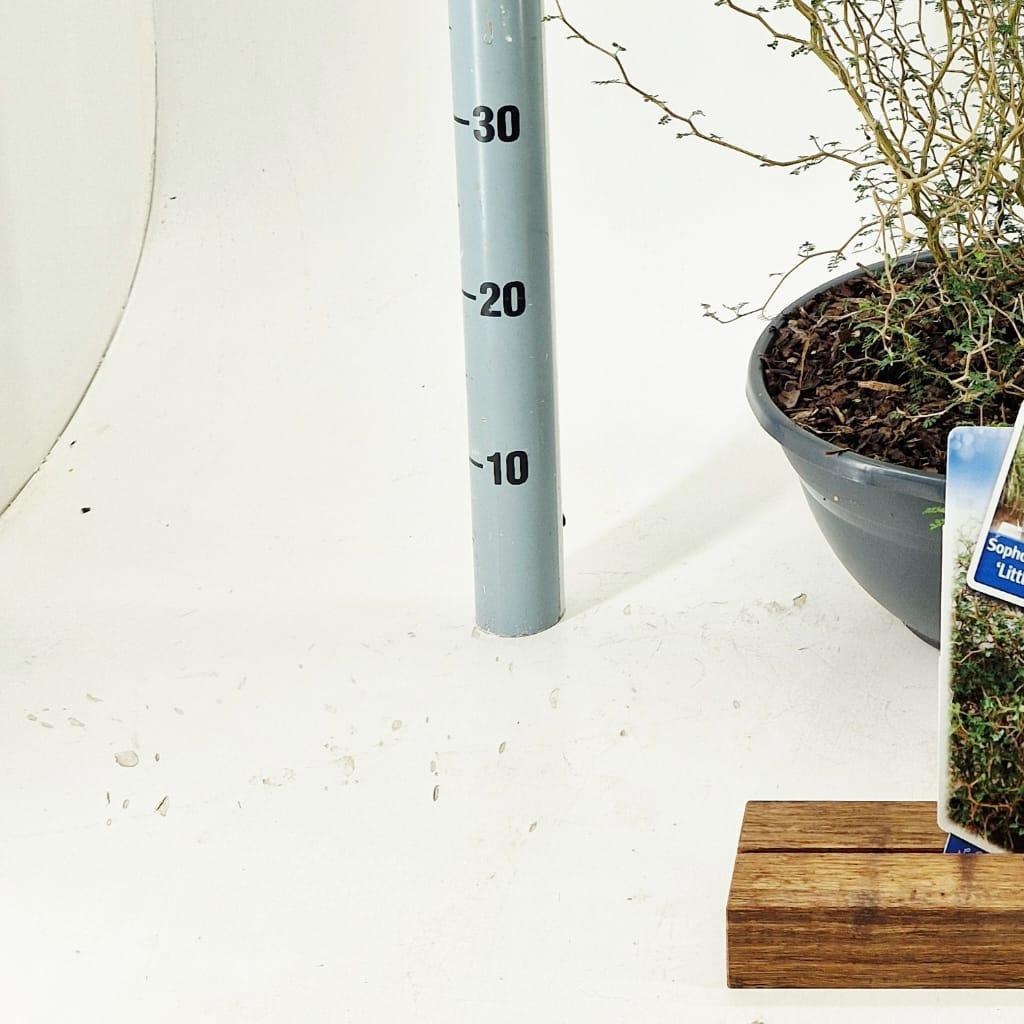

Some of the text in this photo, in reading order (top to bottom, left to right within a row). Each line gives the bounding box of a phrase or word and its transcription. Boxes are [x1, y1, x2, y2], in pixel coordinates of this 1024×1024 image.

[472, 105, 520, 143] 30
[480, 281, 526, 317] 20
[487, 451, 529, 485] 10
